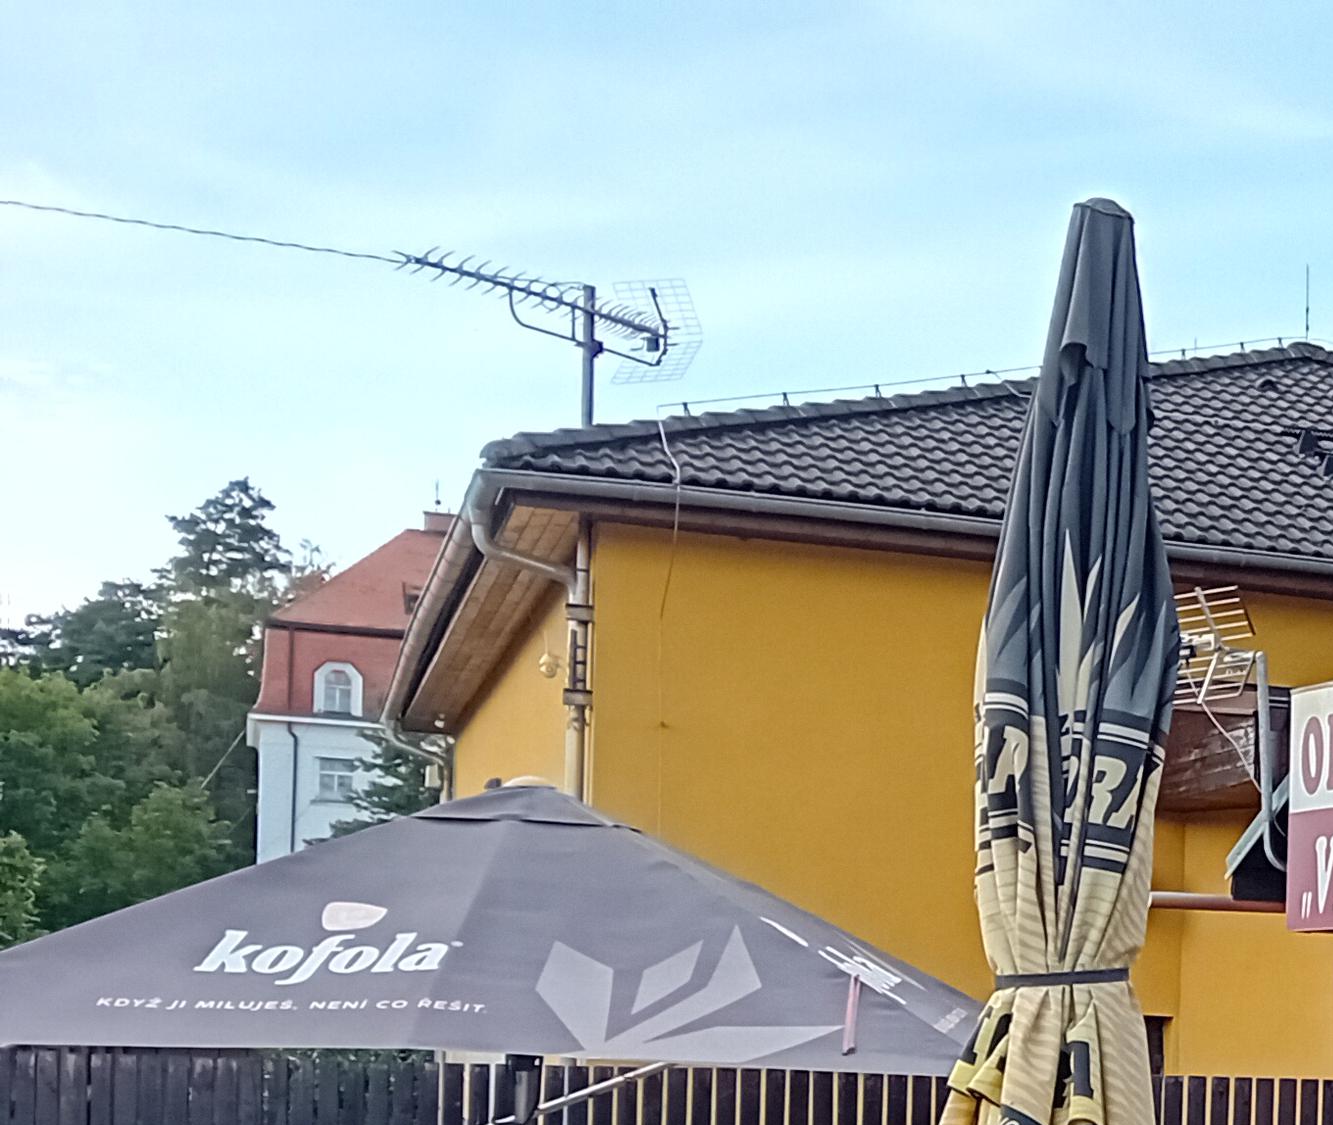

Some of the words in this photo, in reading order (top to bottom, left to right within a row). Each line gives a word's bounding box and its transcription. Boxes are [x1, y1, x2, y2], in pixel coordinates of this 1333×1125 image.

[193, 929, 450, 985] kofola
[96, 997, 158, 1010] KDYŽ
[166, 1000, 187, 1011] JI
[309, 998, 369, 1011] NENÍ
[375, 1000, 409, 1011] CO
